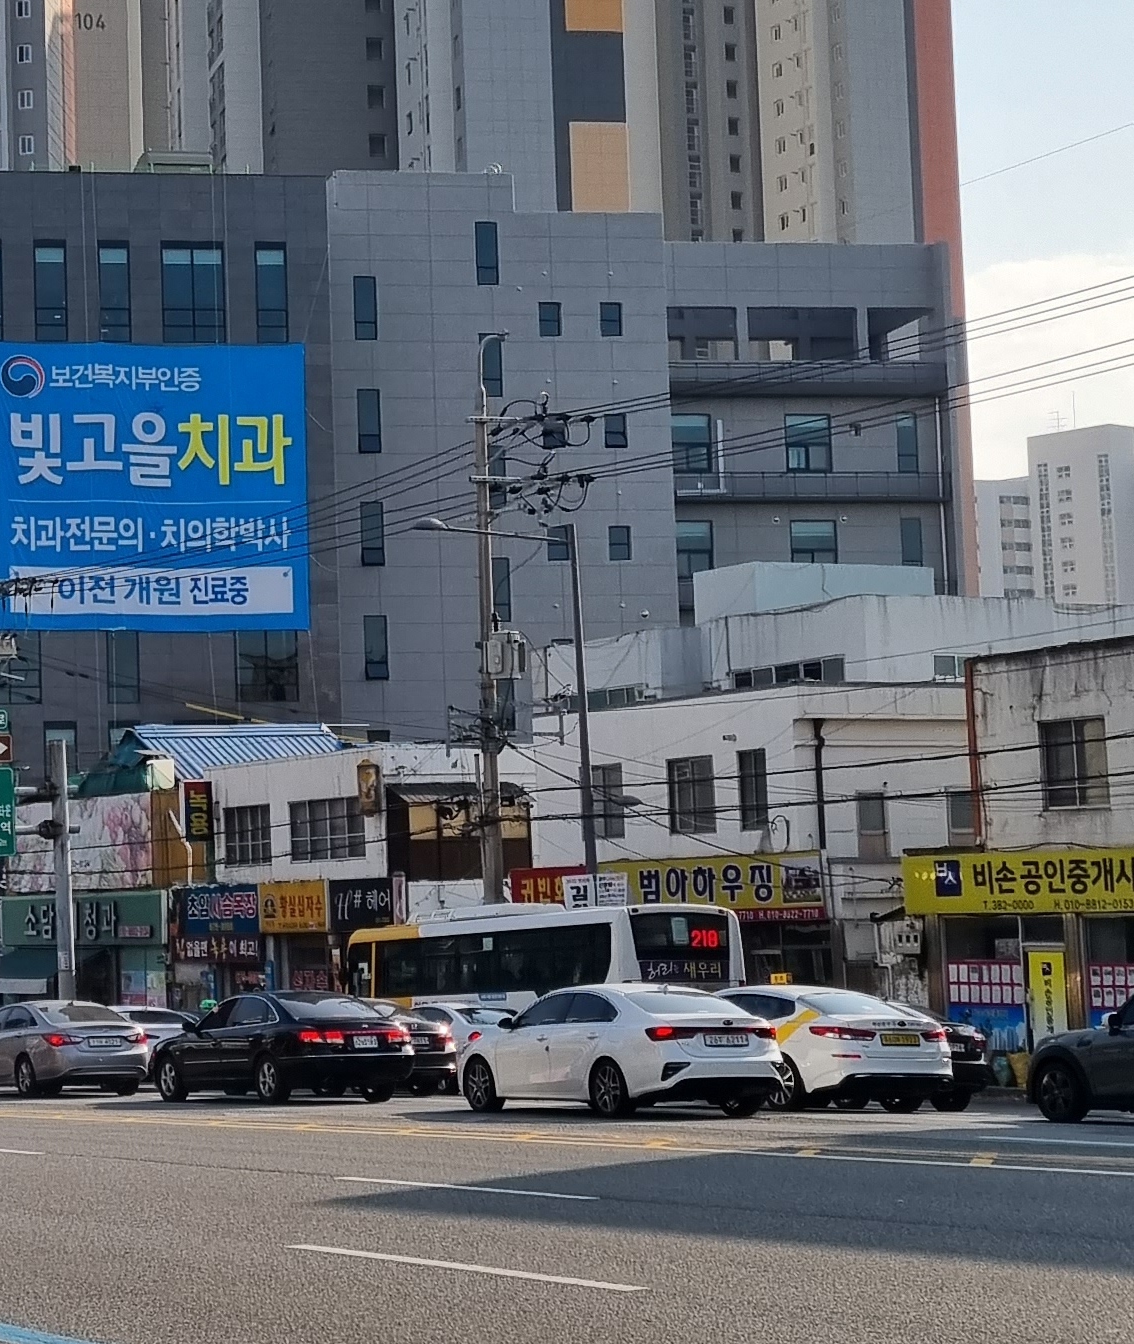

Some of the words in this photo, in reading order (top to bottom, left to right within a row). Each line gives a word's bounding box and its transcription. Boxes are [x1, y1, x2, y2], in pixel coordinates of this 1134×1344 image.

[74, 12, 106, 31] 104
[49, 364, 202, 392] 보건복지부인증
[10, 411, 293, 488] 빛고을치과
[10, 516, 144, 552] 치과전문의
[189, 575, 249, 606] 진료중
[639, 864, 773, 903] 범아하우징
[366, 888, 391, 912] 헤어
[683, 961, 722, 979] 새우리
